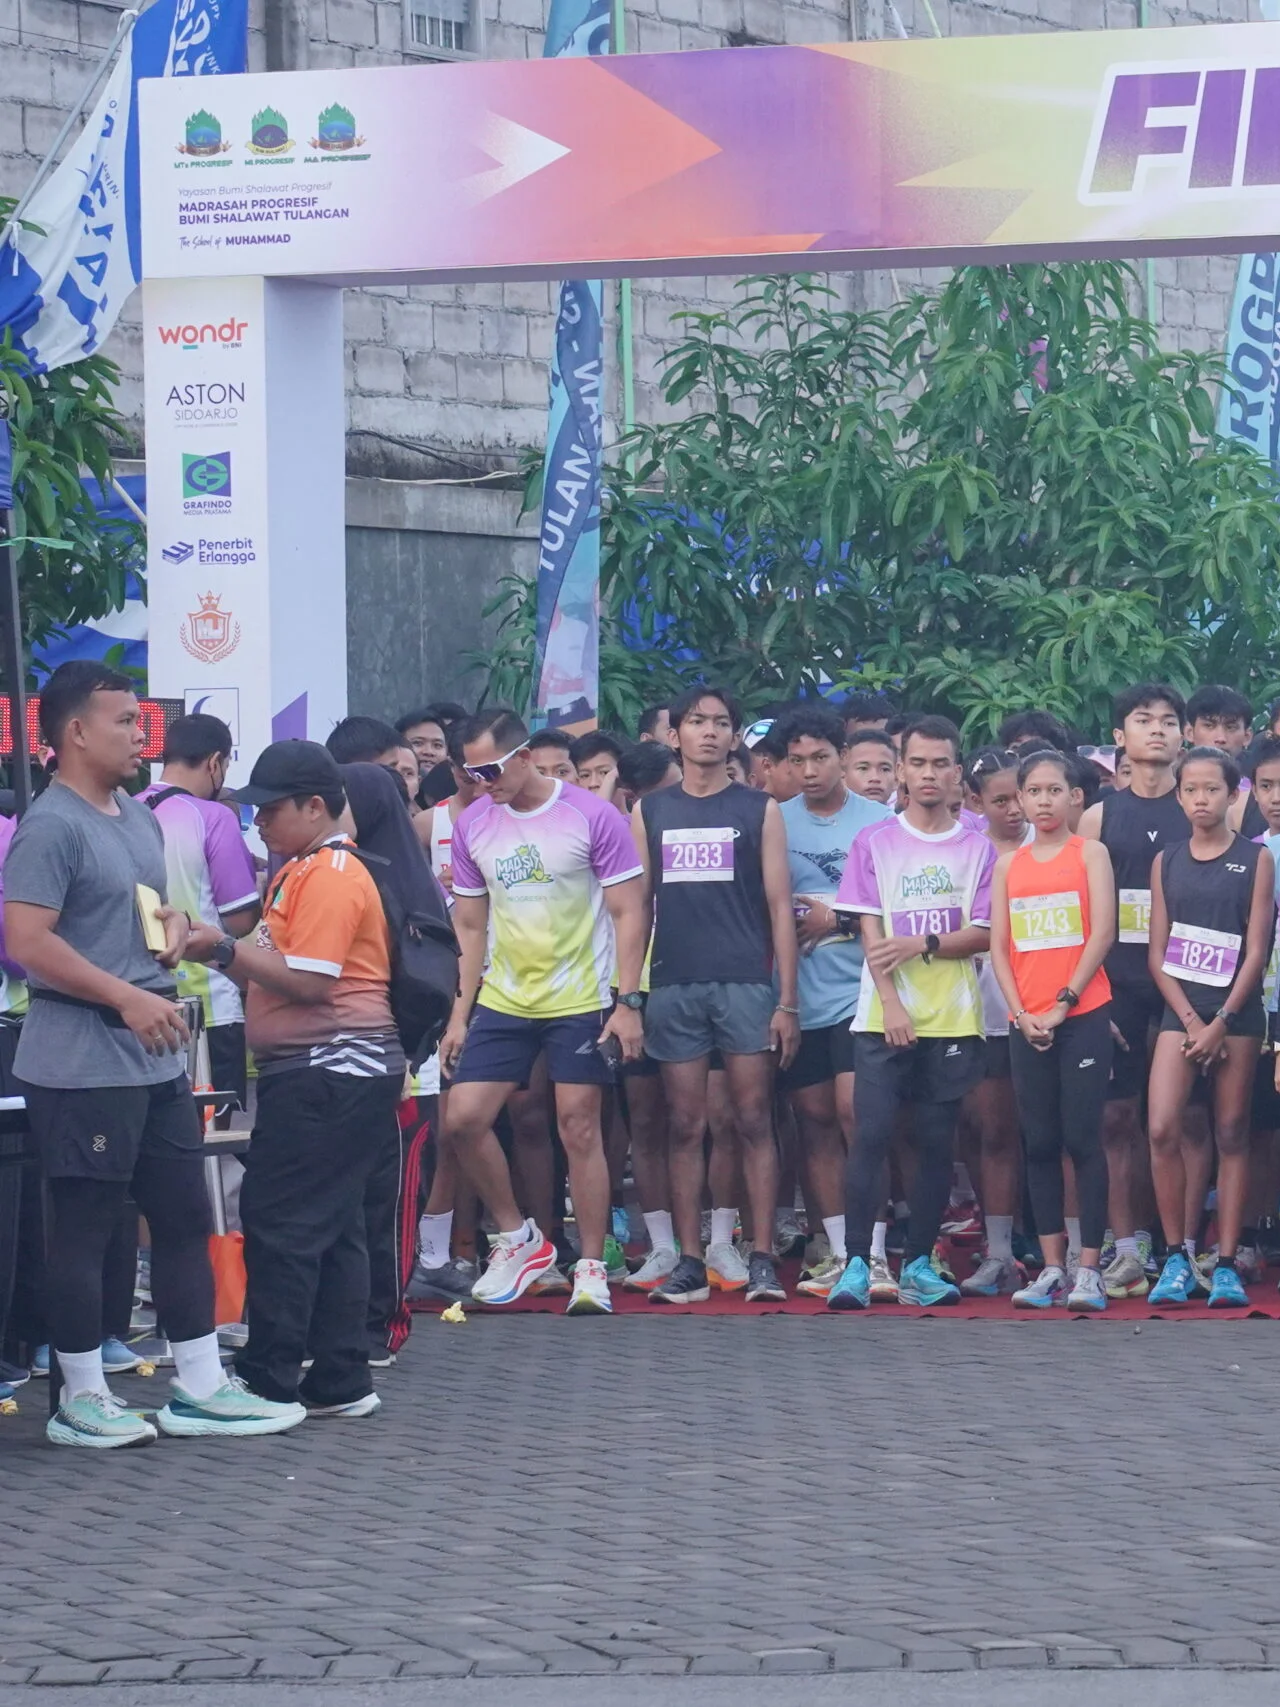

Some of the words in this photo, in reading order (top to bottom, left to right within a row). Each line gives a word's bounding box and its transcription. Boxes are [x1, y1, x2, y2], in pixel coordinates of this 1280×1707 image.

[178, 187, 217, 198] Yayasan
[219, 186, 243, 196] Bumi
[246, 184, 289, 194] Shalawat
[291, 181, 333, 193] Progresif
[178, 200, 248, 213] MADRASAH
[251, 197, 319, 209] PROGRESIF
[179, 214, 210, 225] BUMI
[213, 211, 280, 224] SHALAWAT
[284, 208, 350, 221] TULANGAN
[225, 234, 291, 246] MUHAMMAD
[158, 317, 249, 345] wondr
[166, 382, 245, 406] ASTON
[175, 407, 239, 421] SIDOARJO
[183, 500, 232, 509] GRAFINDO
[199, 537, 253, 551] Penerbit
[199, 551, 256, 565] Erlangga
[671, 843, 722, 868] 2033
[906, 909, 950, 936] 1781
[1024, 909, 1070, 937] 1243
[1133, 905, 1151, 931] 15
[1180, 941, 1225, 972] 1821
